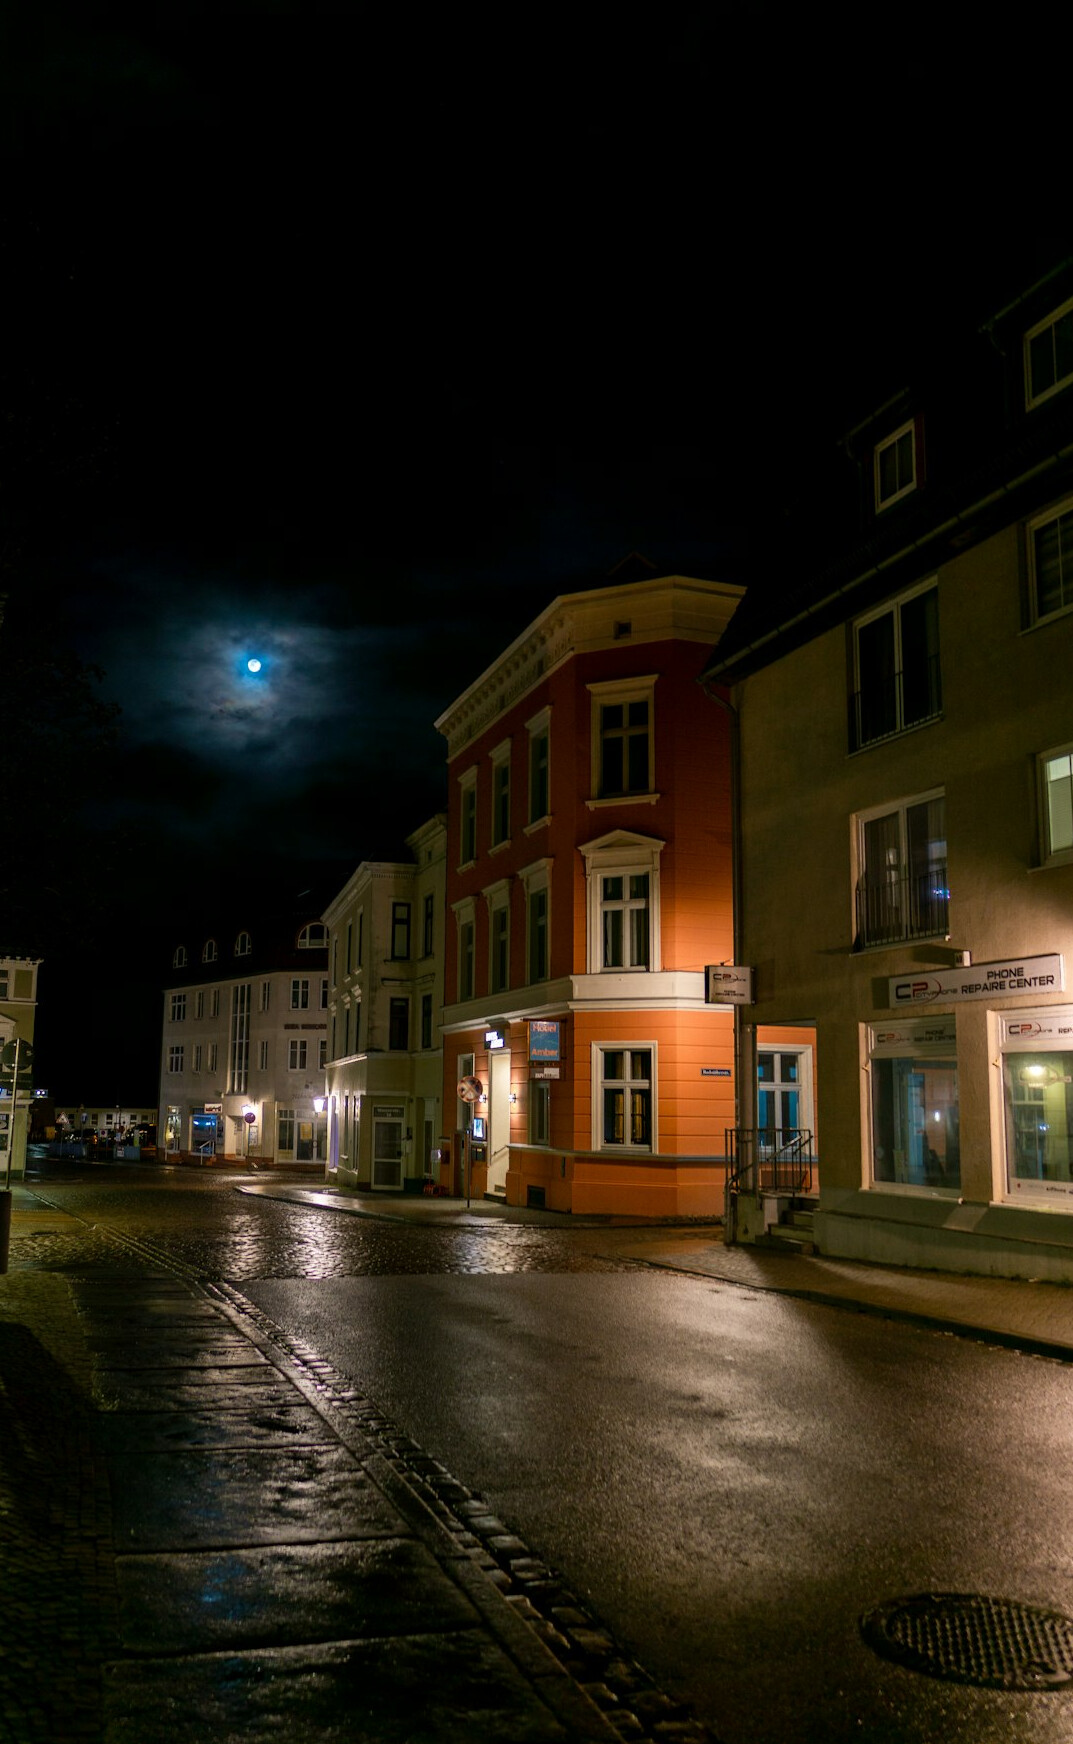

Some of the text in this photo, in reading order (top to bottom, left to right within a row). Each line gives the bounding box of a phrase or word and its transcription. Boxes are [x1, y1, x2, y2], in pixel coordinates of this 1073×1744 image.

[987, 967, 1024, 980] PHONE
[896, 982, 928, 999] CP
[961, 975, 1055, 995] REPAIRE CENTER
